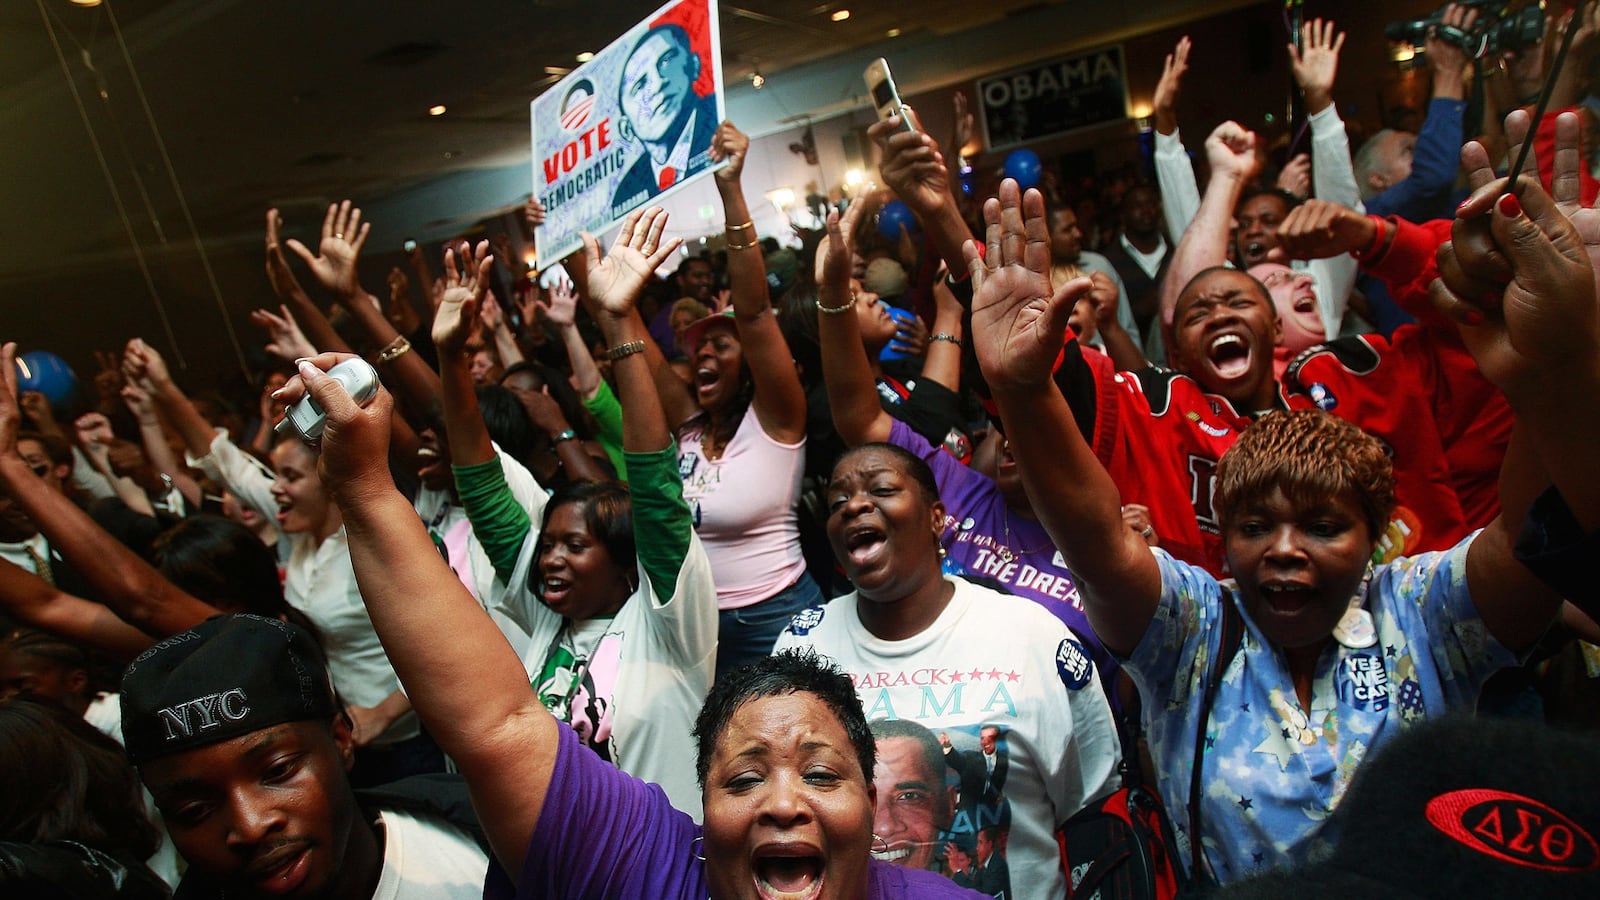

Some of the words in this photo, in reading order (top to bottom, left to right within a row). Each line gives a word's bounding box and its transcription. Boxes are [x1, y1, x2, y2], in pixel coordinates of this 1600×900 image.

[984, 52, 1119, 109] OBAMA
[543, 117, 612, 184] VOTE
[540, 147, 625, 213] DEMOCRATIC
[972, 549, 1018, 583] THE
[1015, 564, 1085, 612] DREA
[1056, 639, 1072, 663] YES
[1063, 646, 1082, 673] WE
[1073, 655, 1089, 681] CAN
[1345, 657, 1382, 671] YES
[1348, 668, 1388, 687] WE
[1354, 683, 1390, 700] CAN
[156, 687, 250, 741] NYC
[865, 682, 1018, 722] AMA
[1474, 805, 1575, 861] ΔΣΘ
